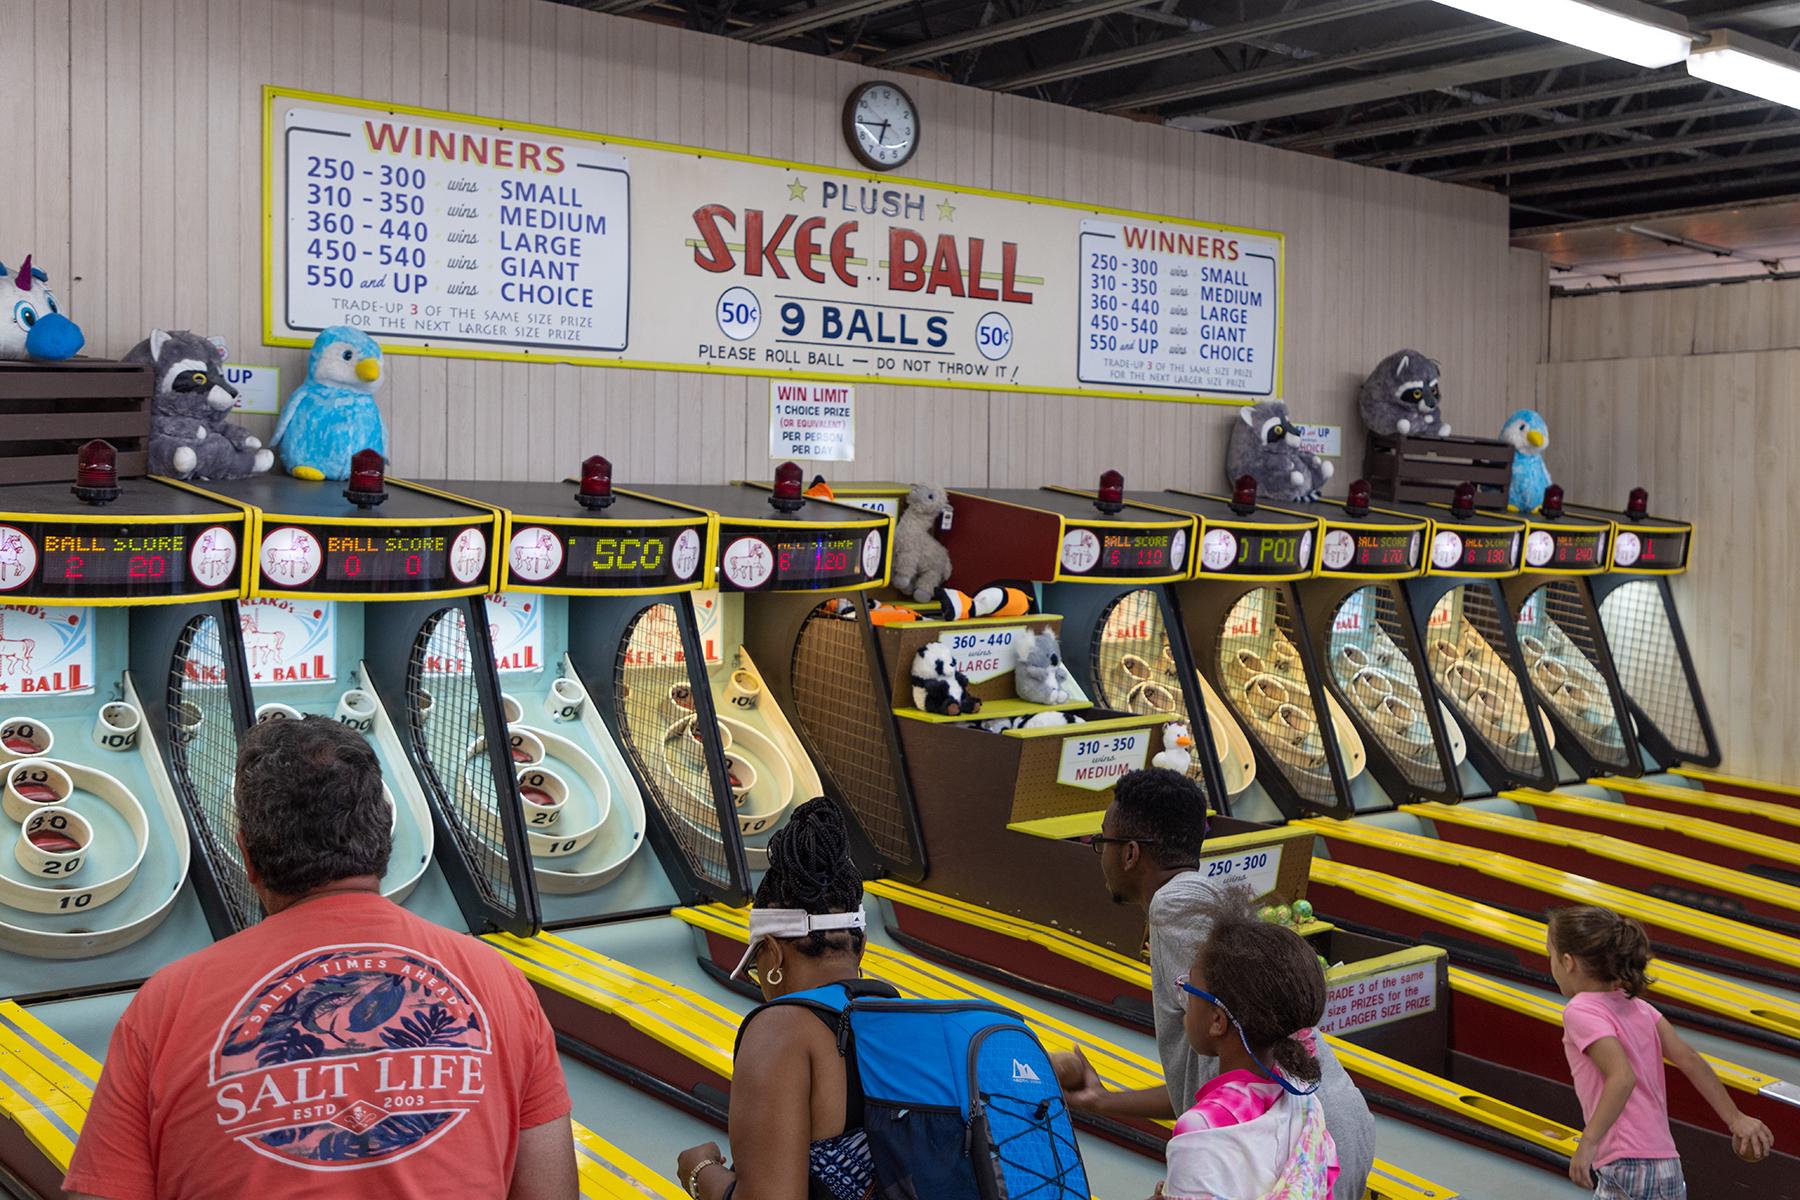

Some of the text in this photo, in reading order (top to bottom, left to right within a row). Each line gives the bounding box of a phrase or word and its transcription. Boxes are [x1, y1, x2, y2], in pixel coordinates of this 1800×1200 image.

[364, 121, 566, 174] WINNERS
[447, 178, 479, 193] wins
[501, 180, 582, 208] SMALL
[822, 181, 925, 221] PLUSH
[447, 204, 479, 219] wins
[501, 206, 606, 235] MEDIUM
[447, 230, 479, 246] wins
[501, 232, 581, 257] LARGE
[1123, 226, 1239, 261] WINNERS
[693, 204, 1033, 304] SKEE BALL
[447, 256, 479, 271] wins
[501, 257, 579, 282] GIANT
[1201, 267, 1248, 287] SMALL
[307, 266, 594, 308] 550 and UP wins CHOICE
[1201, 287, 1262, 307] MEDIUM
[332, 298, 593, 328] TRADE-UP 3 OF THE SAME SIZE PRIZE
[1201, 305, 1247, 324] LARGE
[345, 315, 581, 341] FOR THE NEXT LARGER SIZE PRIZE
[781, 302, 948, 348] 9 BALLS
[1201, 325, 1246, 343] GIANT
[1090, 335, 1116, 351] 550
[1120, 341, 1135, 351] and
[1138, 339, 1158, 355] UP
[1201, 344, 1254, 362] CHOICE
[699, 345, 756, 361] PLEASE
[766, 349, 800, 364] ROLL
[808, 352, 844, 367] BALL
[877, 357, 895, 369] DO
[903, 359, 931, 372] NOT
[938, 362, 989, 377] THROW
[1147, 362, 1152, 370] 3
[1156, 362, 1166, 371] OF
[1170, 363, 1184, 373] THE
[1190, 365, 1210, 375] SAME
[1215, 367, 1229, 376] SIZE
[1234, 369, 1253, 378] PRIZE
[228, 369, 252, 383] UP
[1110, 371, 1125, 379] FOR
[1130, 372, 1144, 381] THE
[1150, 373, 1170, 382] NEXT
[1207, 377, 1221, 386] SIZE
[1227, 379, 1246, 388] PRIZE
[778, 386, 848, 403] WIN LIMIT
[776, 406, 850, 418] 1 CHOICE PRIZE
[780, 418, 794, 429] (OR
[782, 431, 842, 443] PER PERSON
[792, 445, 832, 455] PER DAY
[45, 536, 105, 552] BALL
[328, 537, 444, 552] BALL SCORE
[1134, 536, 1168, 547] SCORE
[1259, 538, 1296, 563] POI
[593, 539, 663, 569] SCO
[815, 553, 847, 570] 120
[1138, 550, 1162, 565] 110
[65, 555, 165, 578] 2 20
[345, 556, 420, 576] 0 0
[273, 655, 330, 681] BALL
[957, 658, 999, 673] LARGE
[21, 664, 88, 692] BALL
[1092, 755, 1115, 764] wins
[14, 770, 48, 784] 40
[1075, 763, 1129, 780] MEDIUM
[29, 815, 67, 830] 30
[532, 810, 560, 824] 20
[742, 820, 765, 831] 10
[550, 840, 576, 852] 10
[43, 857, 80, 874] 20
[59, 893, 92, 909] 10
[250, 959, 458, 1023] SALTY TIMES AHEAD
[1328, 971, 1424, 1002] RADE 3 of the same
[1328, 986, 1418, 1017] size PRIZES for the
[1339, 995, 1430, 1029] LARGER SIZE PRIZE
[216, 1055, 484, 1125] SALT LIFE
[293, 1095, 424, 1120] ESTD 2003
